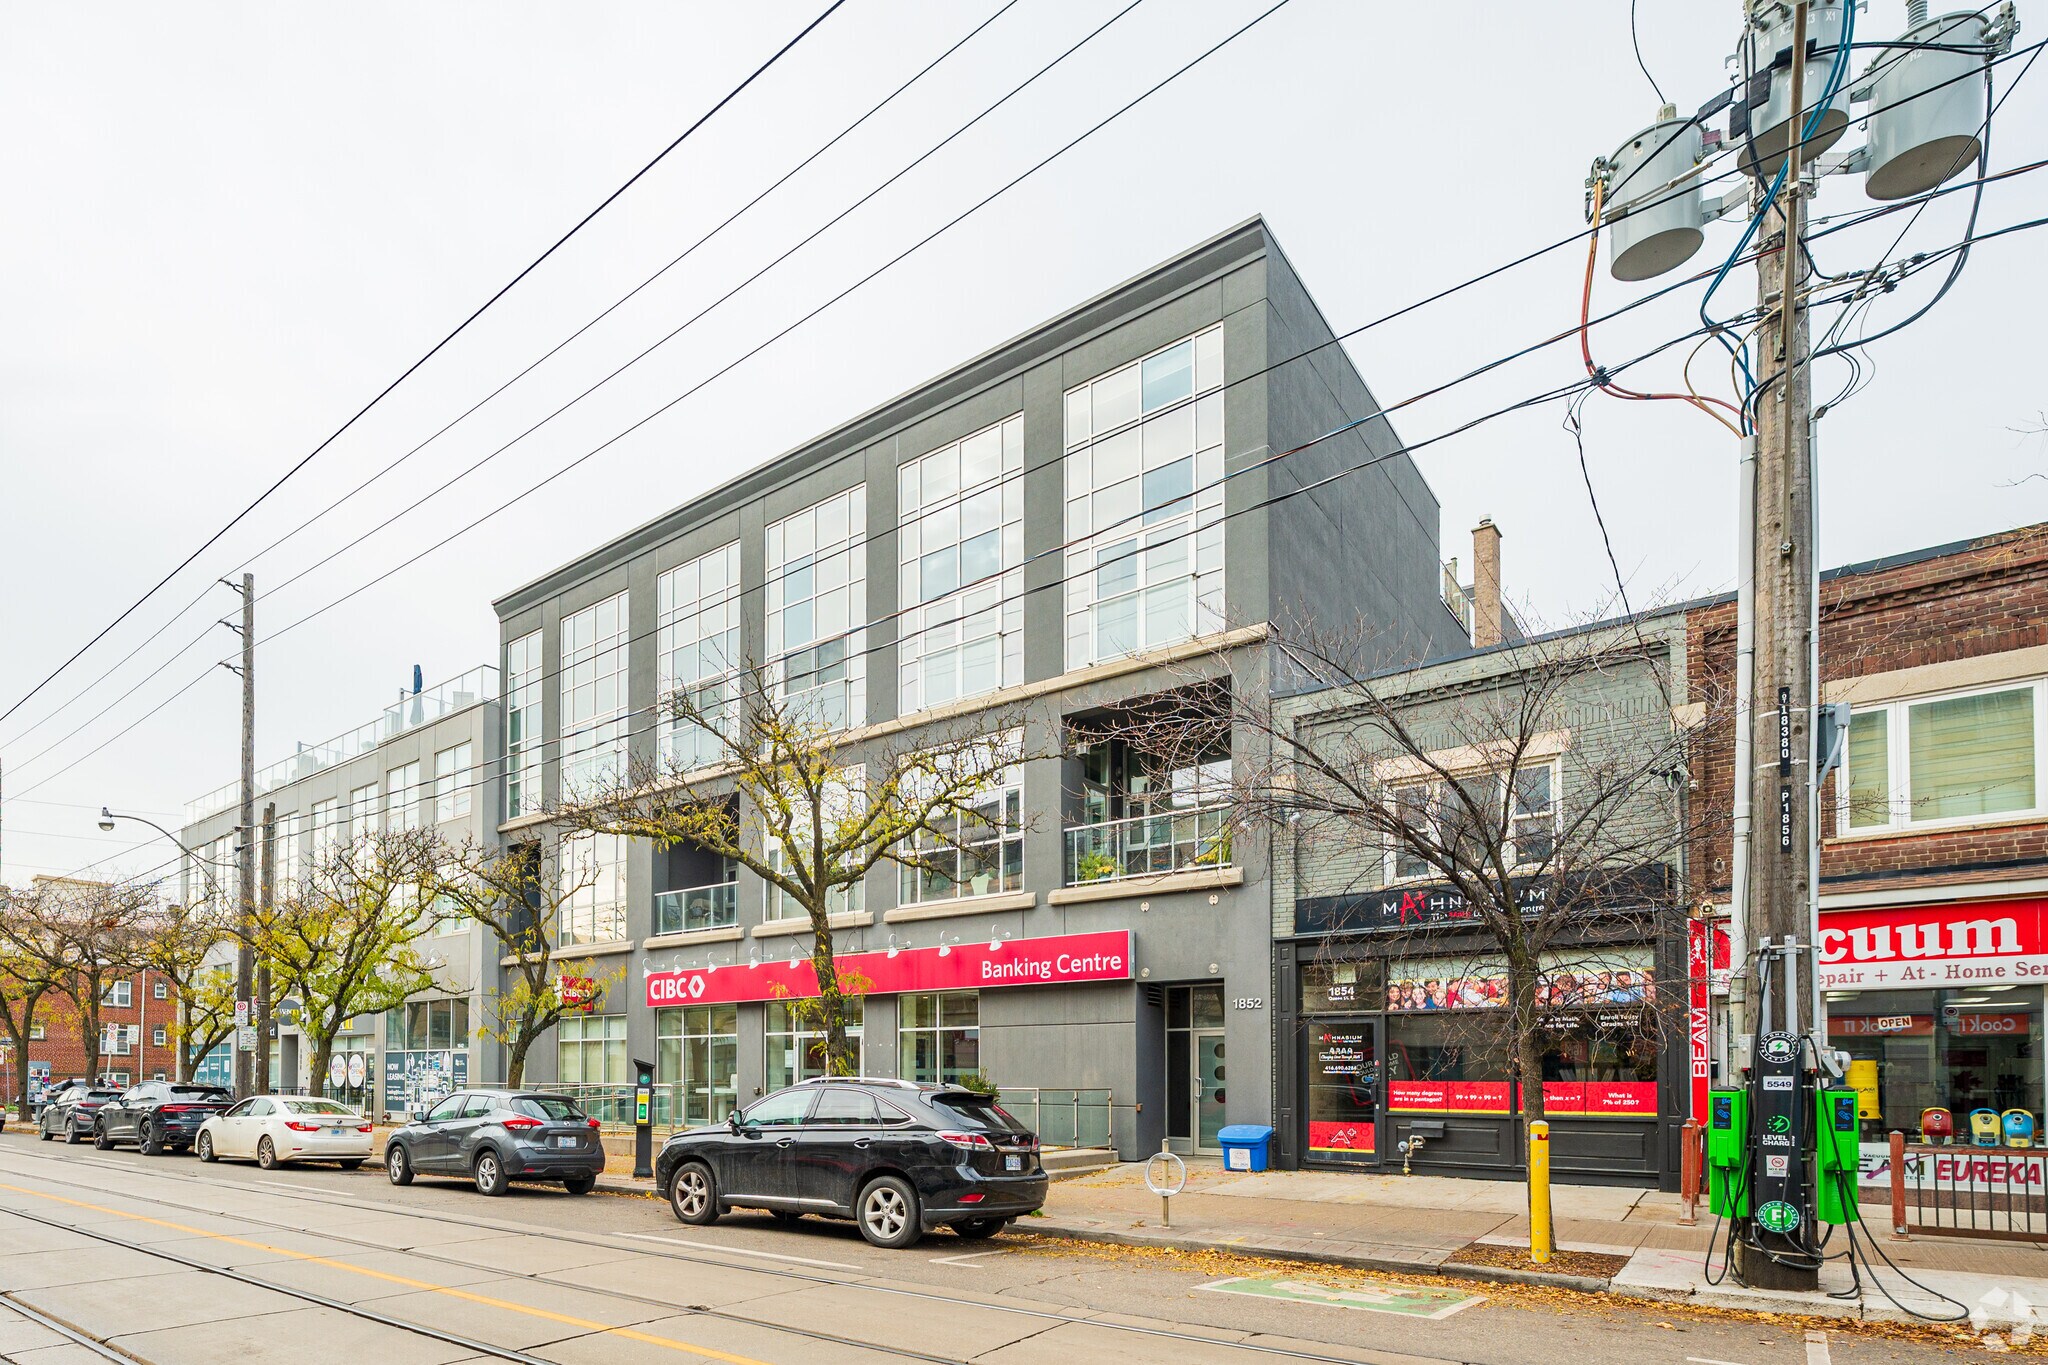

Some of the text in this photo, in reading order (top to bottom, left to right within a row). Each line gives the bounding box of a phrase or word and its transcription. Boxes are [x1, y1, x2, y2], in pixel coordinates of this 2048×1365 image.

[1807, 13, 1816, 24] 3
[1825, 11, 1837, 21] X1
[1779, 24, 1792, 36] X2
[1759, 36, 1771, 51] X4
[1781, 705, 1789, 758] 18380
[1782, 792, 1790, 845] P1856
[1520, 905, 1545, 914] entre
[1820, 917, 2023, 962] cuum
[982, 953, 1122, 979] Banking Centre
[1820, 968, 1864, 986] epair
[1944, 964, 2006, 980] Home
[650, 977, 687, 1000] CIBC
[1328, 986, 1355, 996] 1854
[1232, 998, 1262, 1009] 1852
[1880, 1017, 1910, 1029] OPEN
[1692, 1007, 1708, 1078] BEAM
[1766, 1080, 1792, 1088] 5549
[1937, 1159, 2042, 1185] EUREKA
